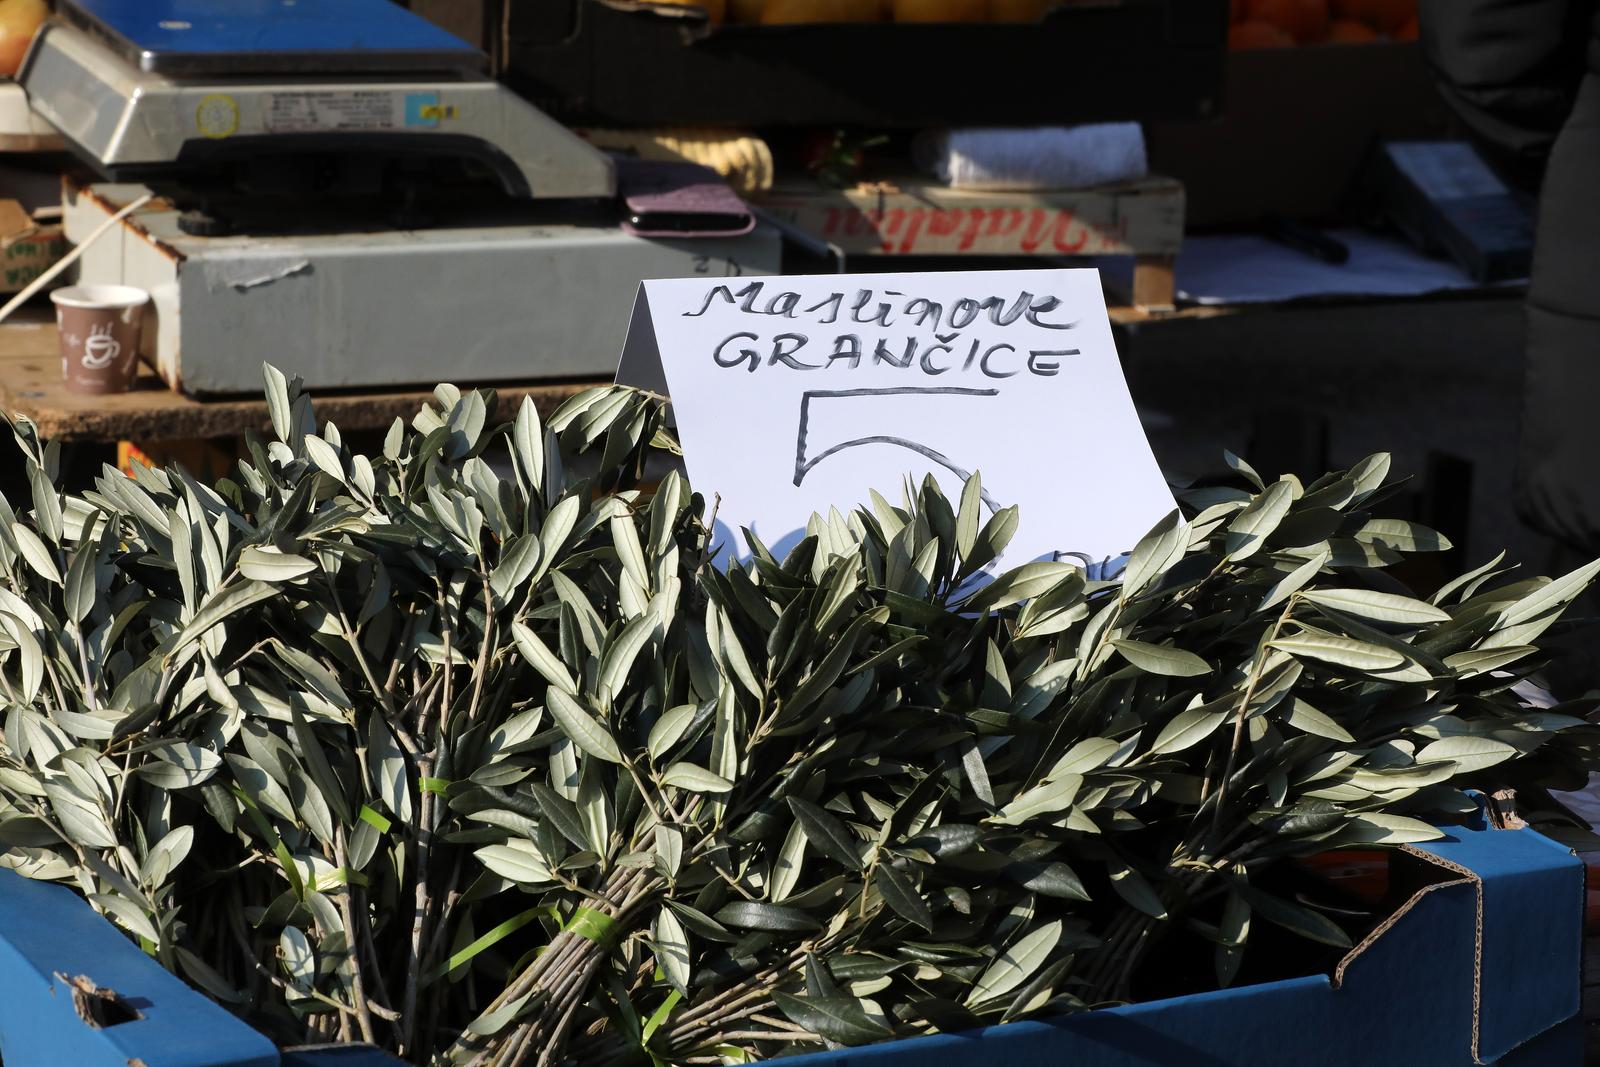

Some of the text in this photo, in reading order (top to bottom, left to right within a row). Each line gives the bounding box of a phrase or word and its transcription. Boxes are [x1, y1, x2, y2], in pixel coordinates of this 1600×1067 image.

[682, 281, 1080, 335] Maslinove
[713, 331, 1080, 379] GRANČICE
[792, 386, 1004, 599] 5
